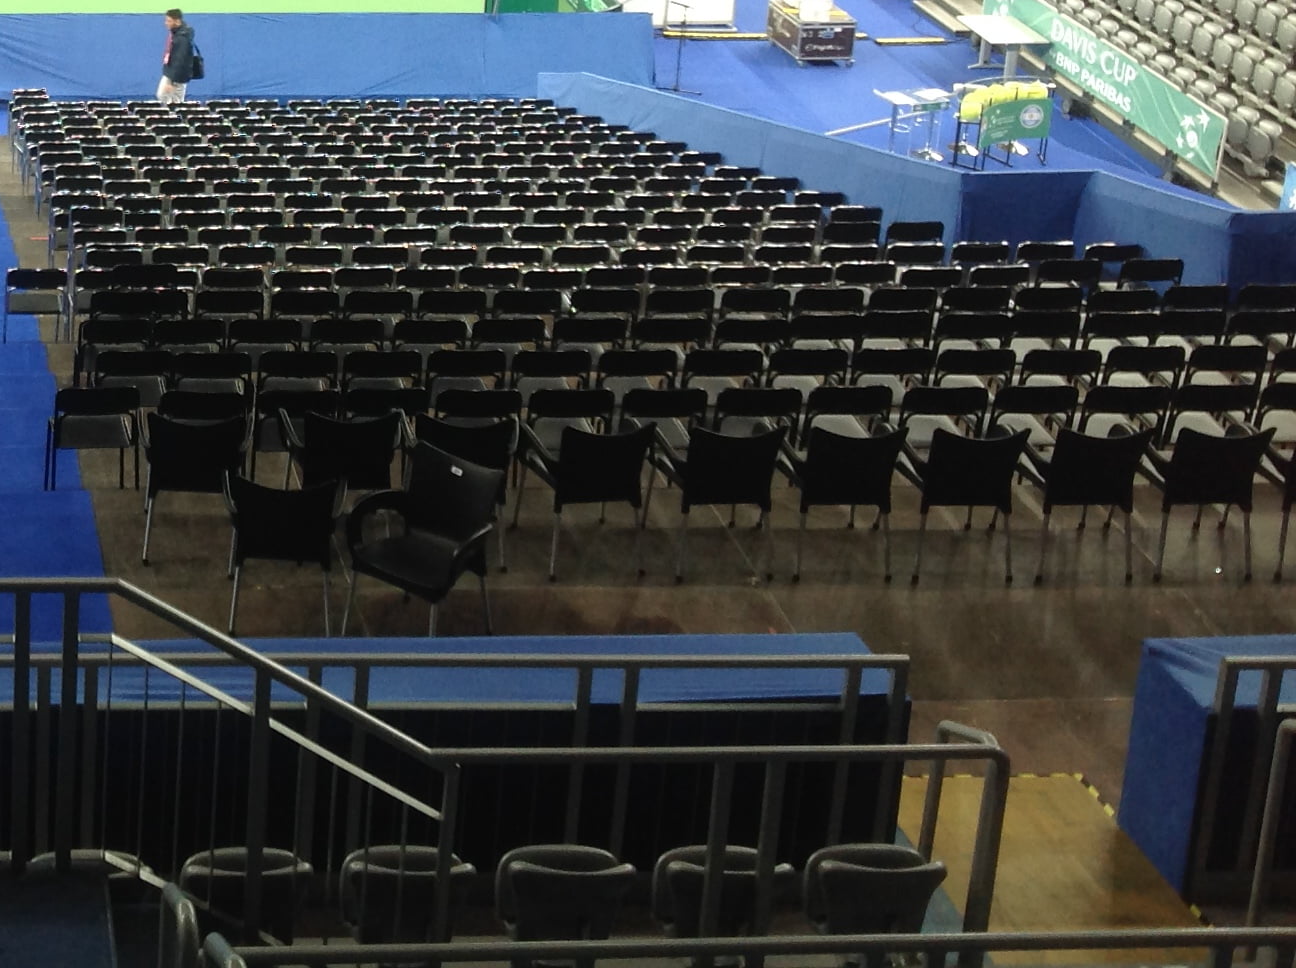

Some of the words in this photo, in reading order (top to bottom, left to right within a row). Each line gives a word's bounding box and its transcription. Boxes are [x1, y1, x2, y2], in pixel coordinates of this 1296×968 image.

[1050, 18, 1097, 64] DAVIS
[1100, 52, 1137, 86] CUP
[1055, 52, 1080, 76] BNP
[1080, 69, 1132, 112] PARIBAS
